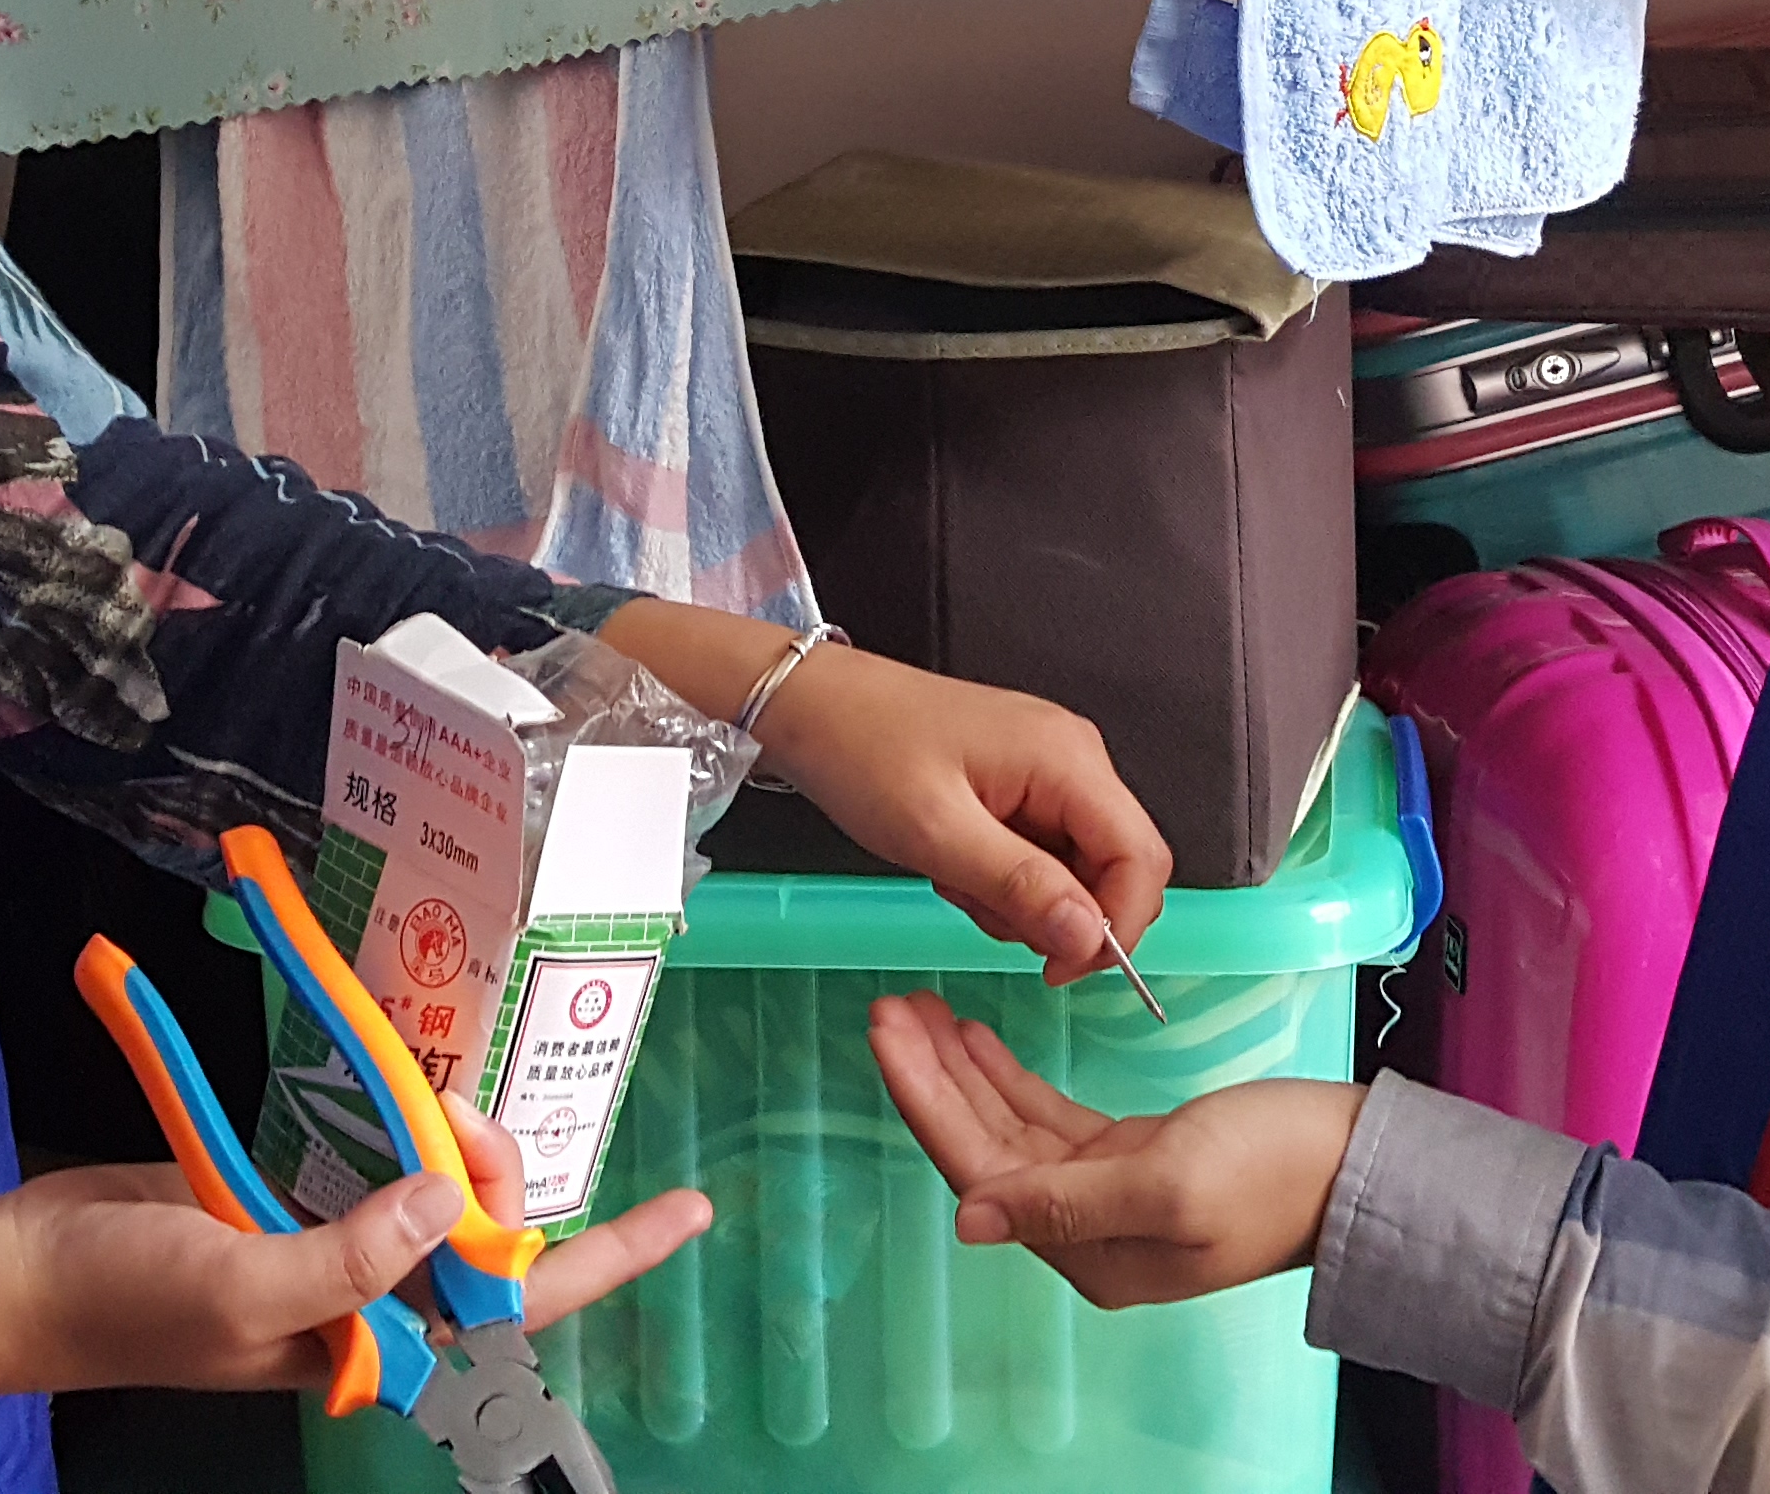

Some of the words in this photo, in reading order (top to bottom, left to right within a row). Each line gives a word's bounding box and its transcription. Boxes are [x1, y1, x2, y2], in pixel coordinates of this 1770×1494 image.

[343, 770, 398, 826] 规格
[418, 1003, 456, 1039] 钢
[409, 1047, 462, 1092] 钉
[526, 1060, 614, 1082] 质量放心品牌
